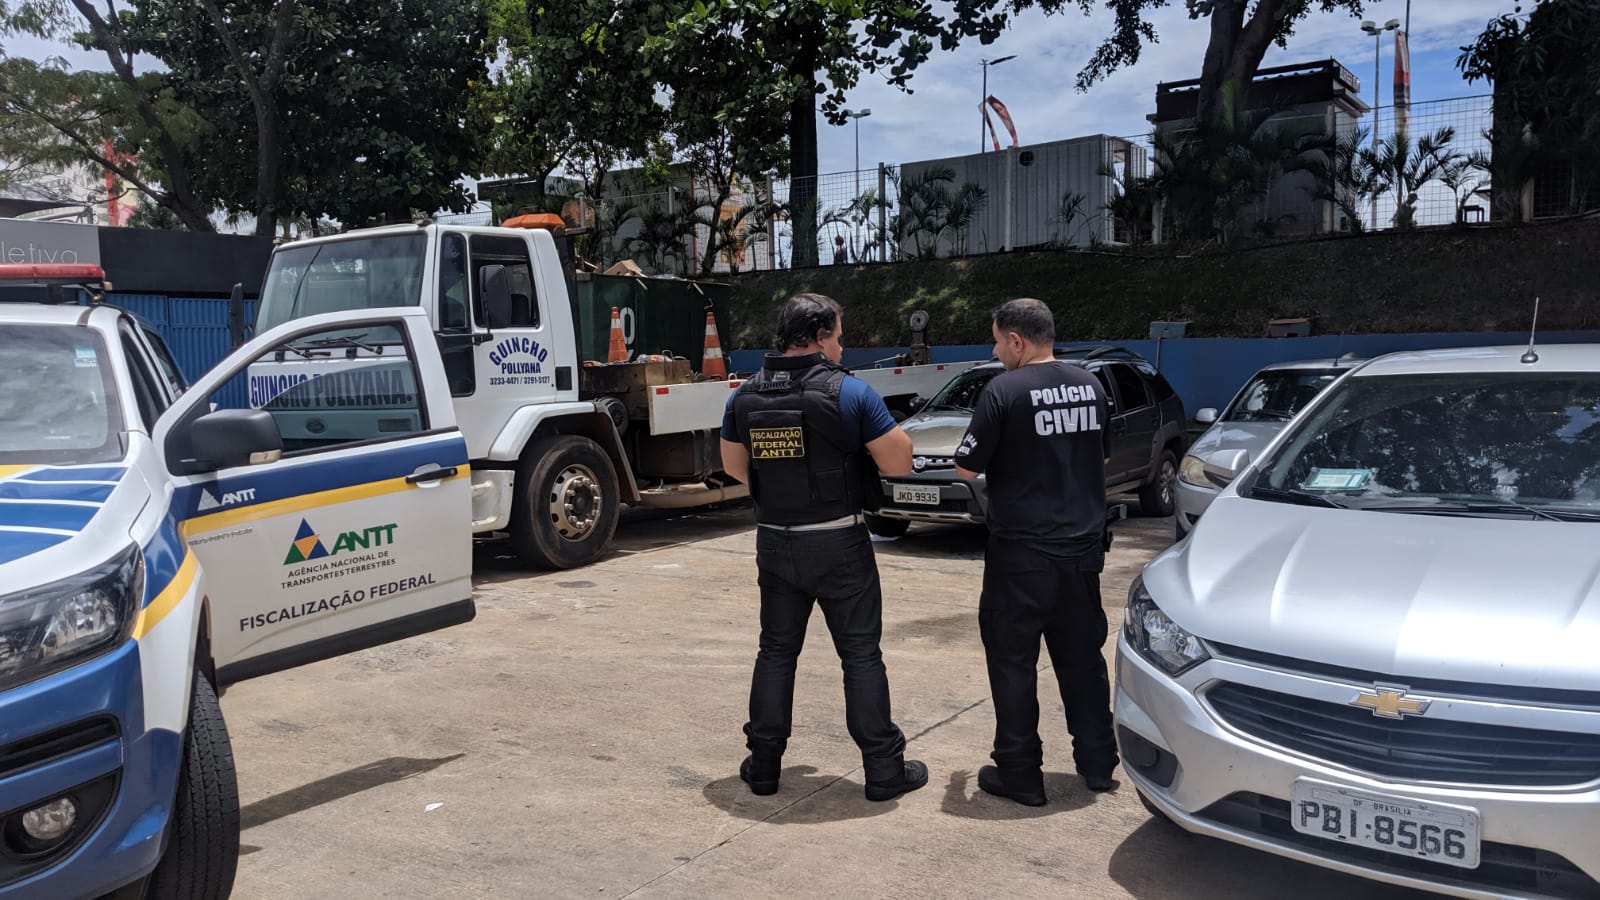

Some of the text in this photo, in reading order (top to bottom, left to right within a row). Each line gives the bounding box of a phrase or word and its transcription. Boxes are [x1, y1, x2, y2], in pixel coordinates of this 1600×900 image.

[488, 336, 548, 366] GUINCHO
[501, 362, 541, 375] POLLYANA
[250, 373, 310, 408] GUINCHO
[1030, 384, 1097, 406] POLÍCIA
[1034, 405, 1101, 436] CIVIL
[753, 440, 802, 449] FEDERAL
[760, 448, 796, 457] ANTT
[221, 487, 256, 506] ANTT
[330, 523, 398, 555] ANTT
[281, 558, 397, 589] TRANSPORTES TERRESTRES
[287, 550, 389, 578] AGÊNCIA NACIONAL DE
[239, 573, 436, 631] FISCALIZAÇÃO FEDERAL
